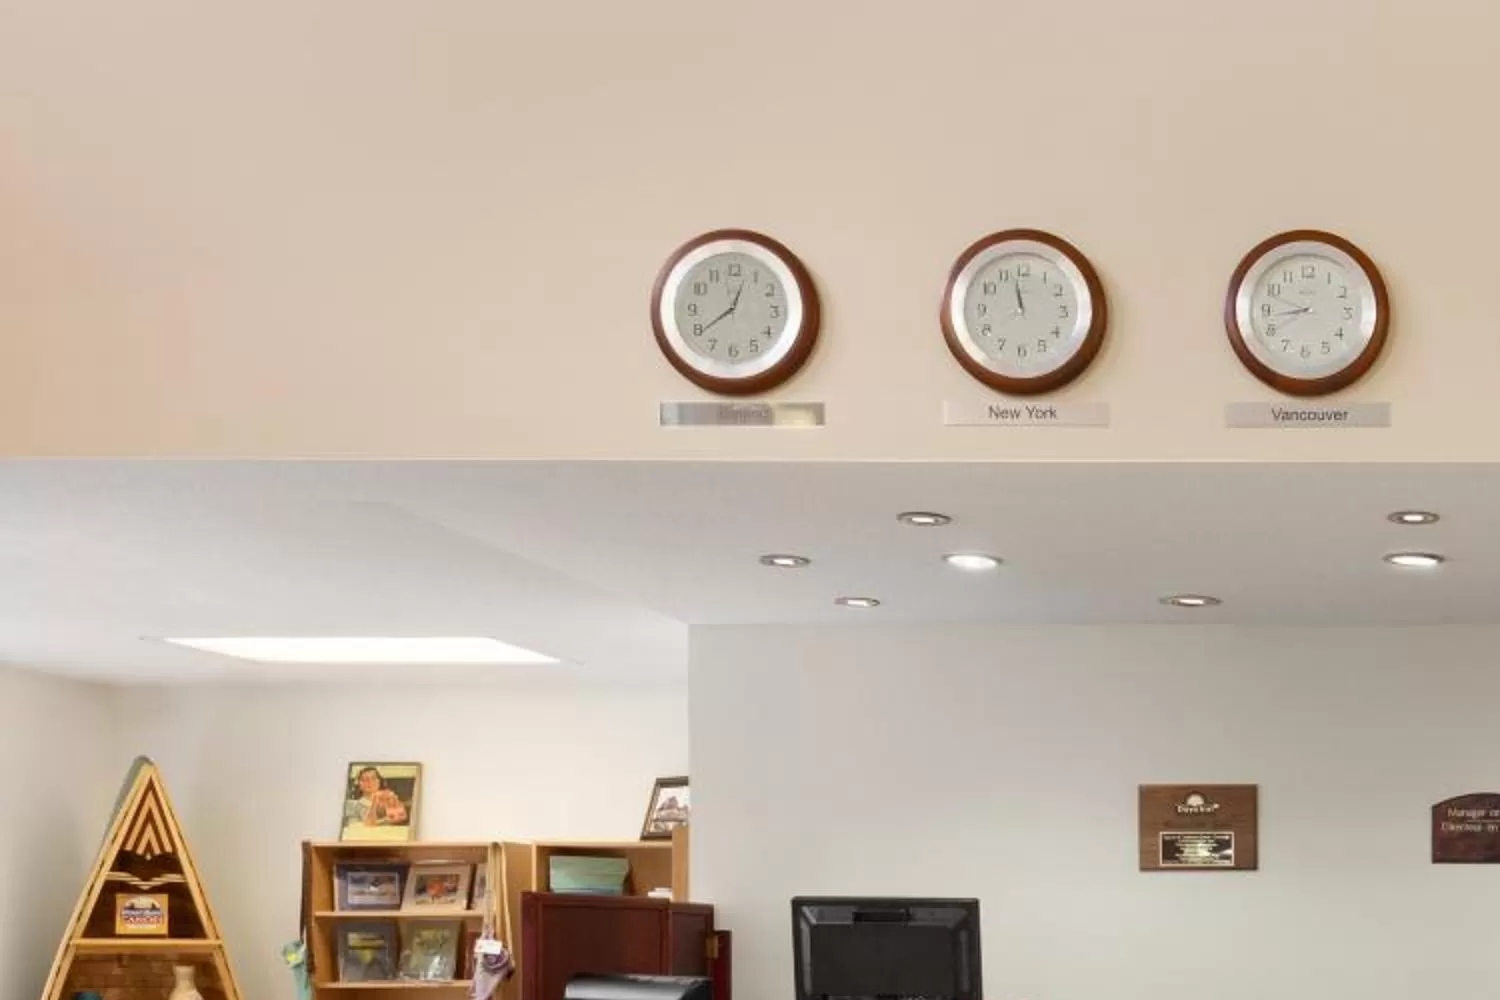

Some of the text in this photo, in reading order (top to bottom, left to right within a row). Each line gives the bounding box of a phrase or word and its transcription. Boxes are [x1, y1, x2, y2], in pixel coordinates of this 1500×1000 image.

[988, 405, 1057, 419] New York
[1271, 407, 1349, 421] Vancouver
[1448, 807, 1485, 818] Manager
